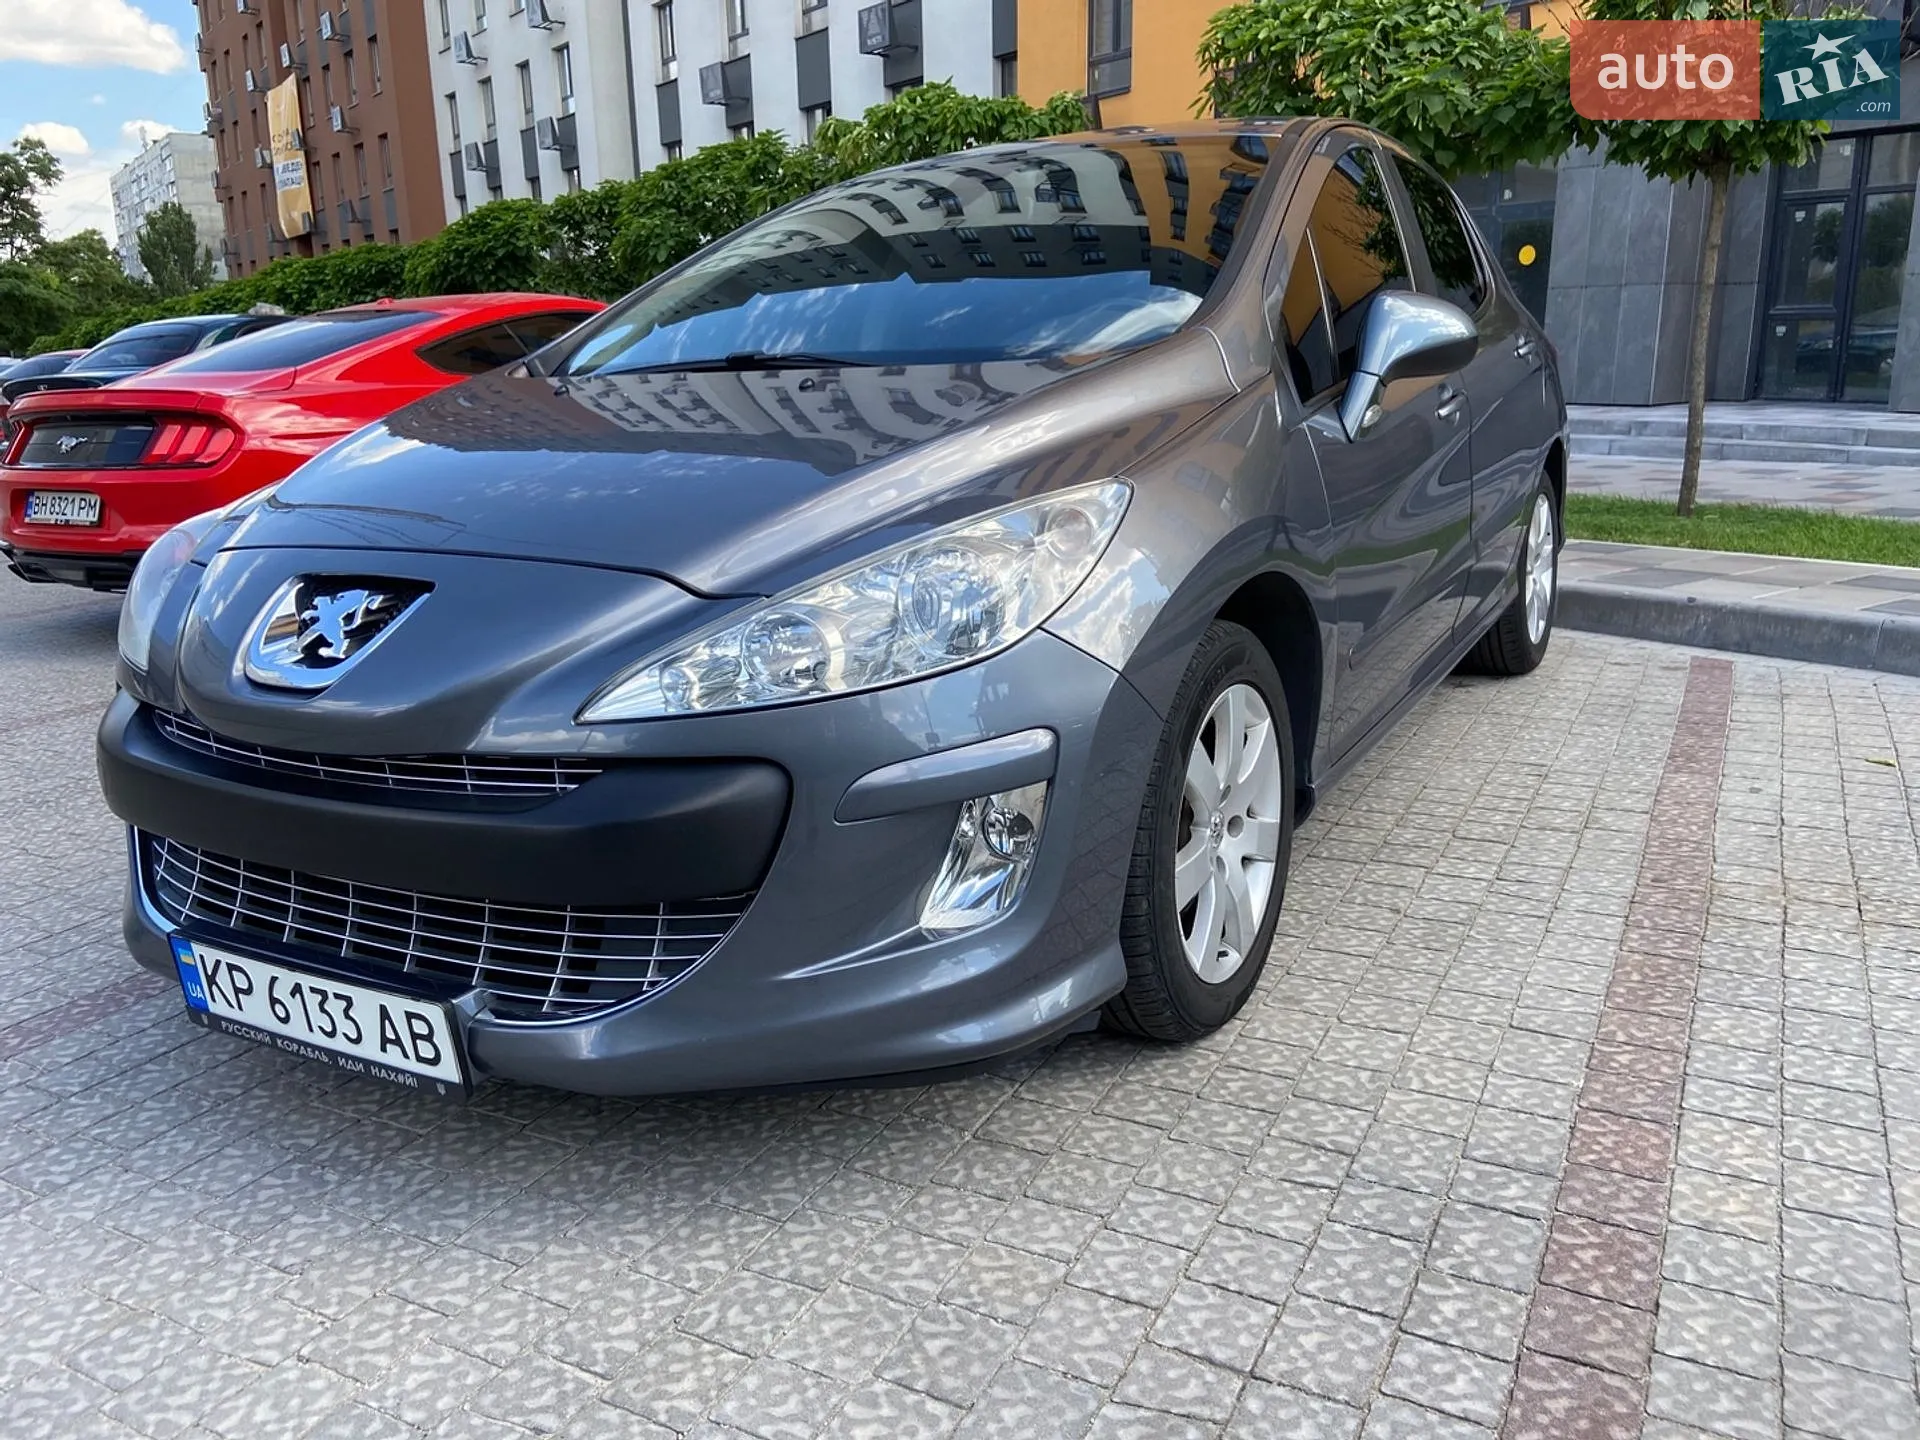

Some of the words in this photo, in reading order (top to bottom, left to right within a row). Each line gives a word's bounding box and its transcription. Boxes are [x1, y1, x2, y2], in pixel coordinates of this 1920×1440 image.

[33, 495, 48, 516] BH
[49, 496, 76, 517] 8321
[77, 497, 98, 518] PM
[187, 981, 205, 1001] UA
[199, 953, 254, 1012] KP
[268, 976, 363, 1045] 6133
[379, 1003, 442, 1067] AB
[220, 1020, 272, 1046] РУССКИЙ
[337, 1056, 366, 1073] ИДИ
